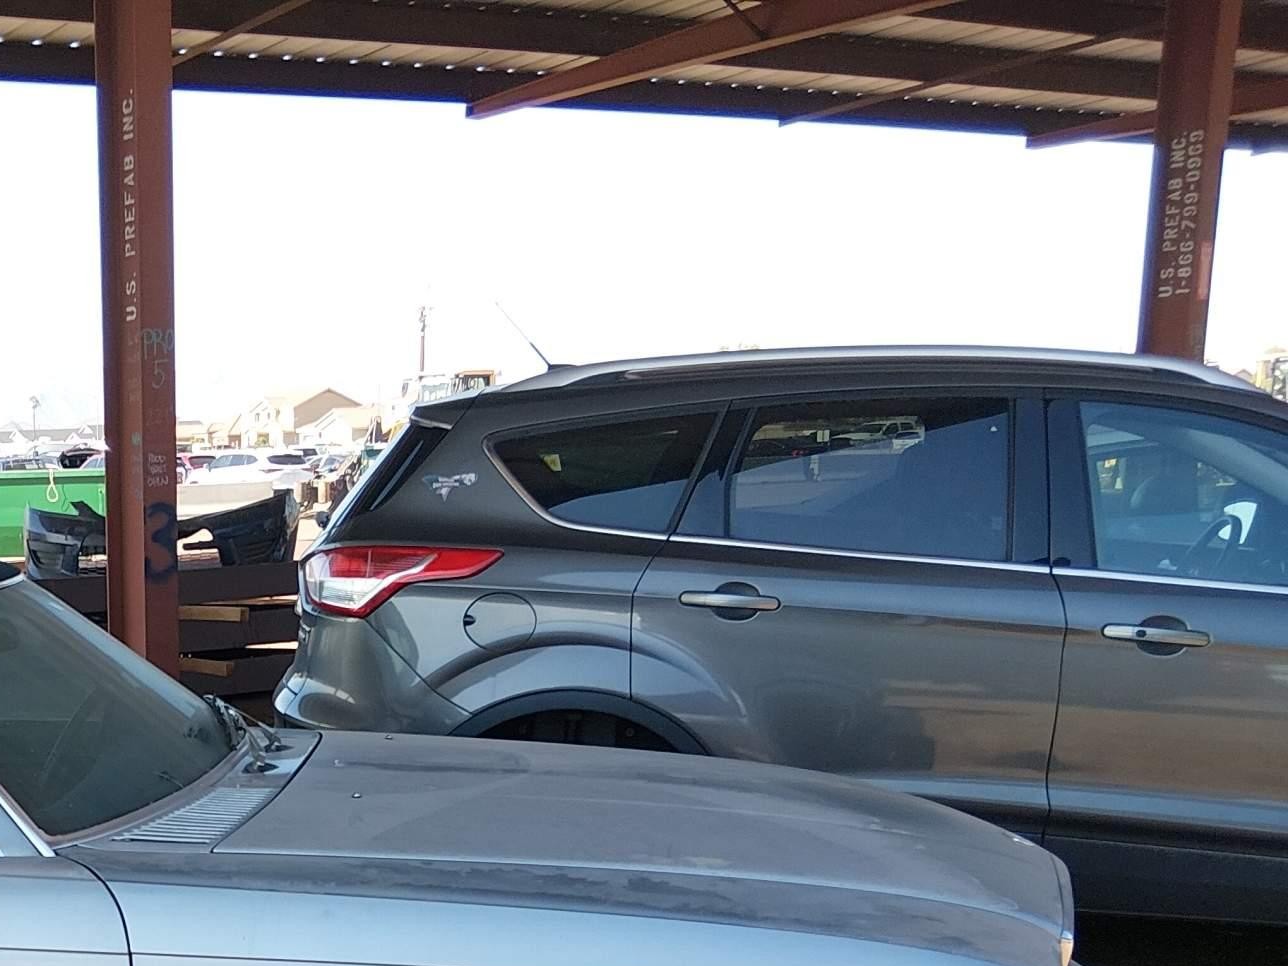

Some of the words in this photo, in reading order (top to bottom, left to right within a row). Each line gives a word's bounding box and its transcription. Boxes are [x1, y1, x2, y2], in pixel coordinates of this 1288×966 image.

[122, 88, 134, 140] INC.
[1170, 132, 1187, 169] INC.
[123, 154, 136, 257] PREFAB
[1163, 177, 1183, 252] PREFAB
[125, 272, 137, 322] U.S.
[1158, 262, 1176, 298] U.S.
[144, 502, 179, 584] 3
